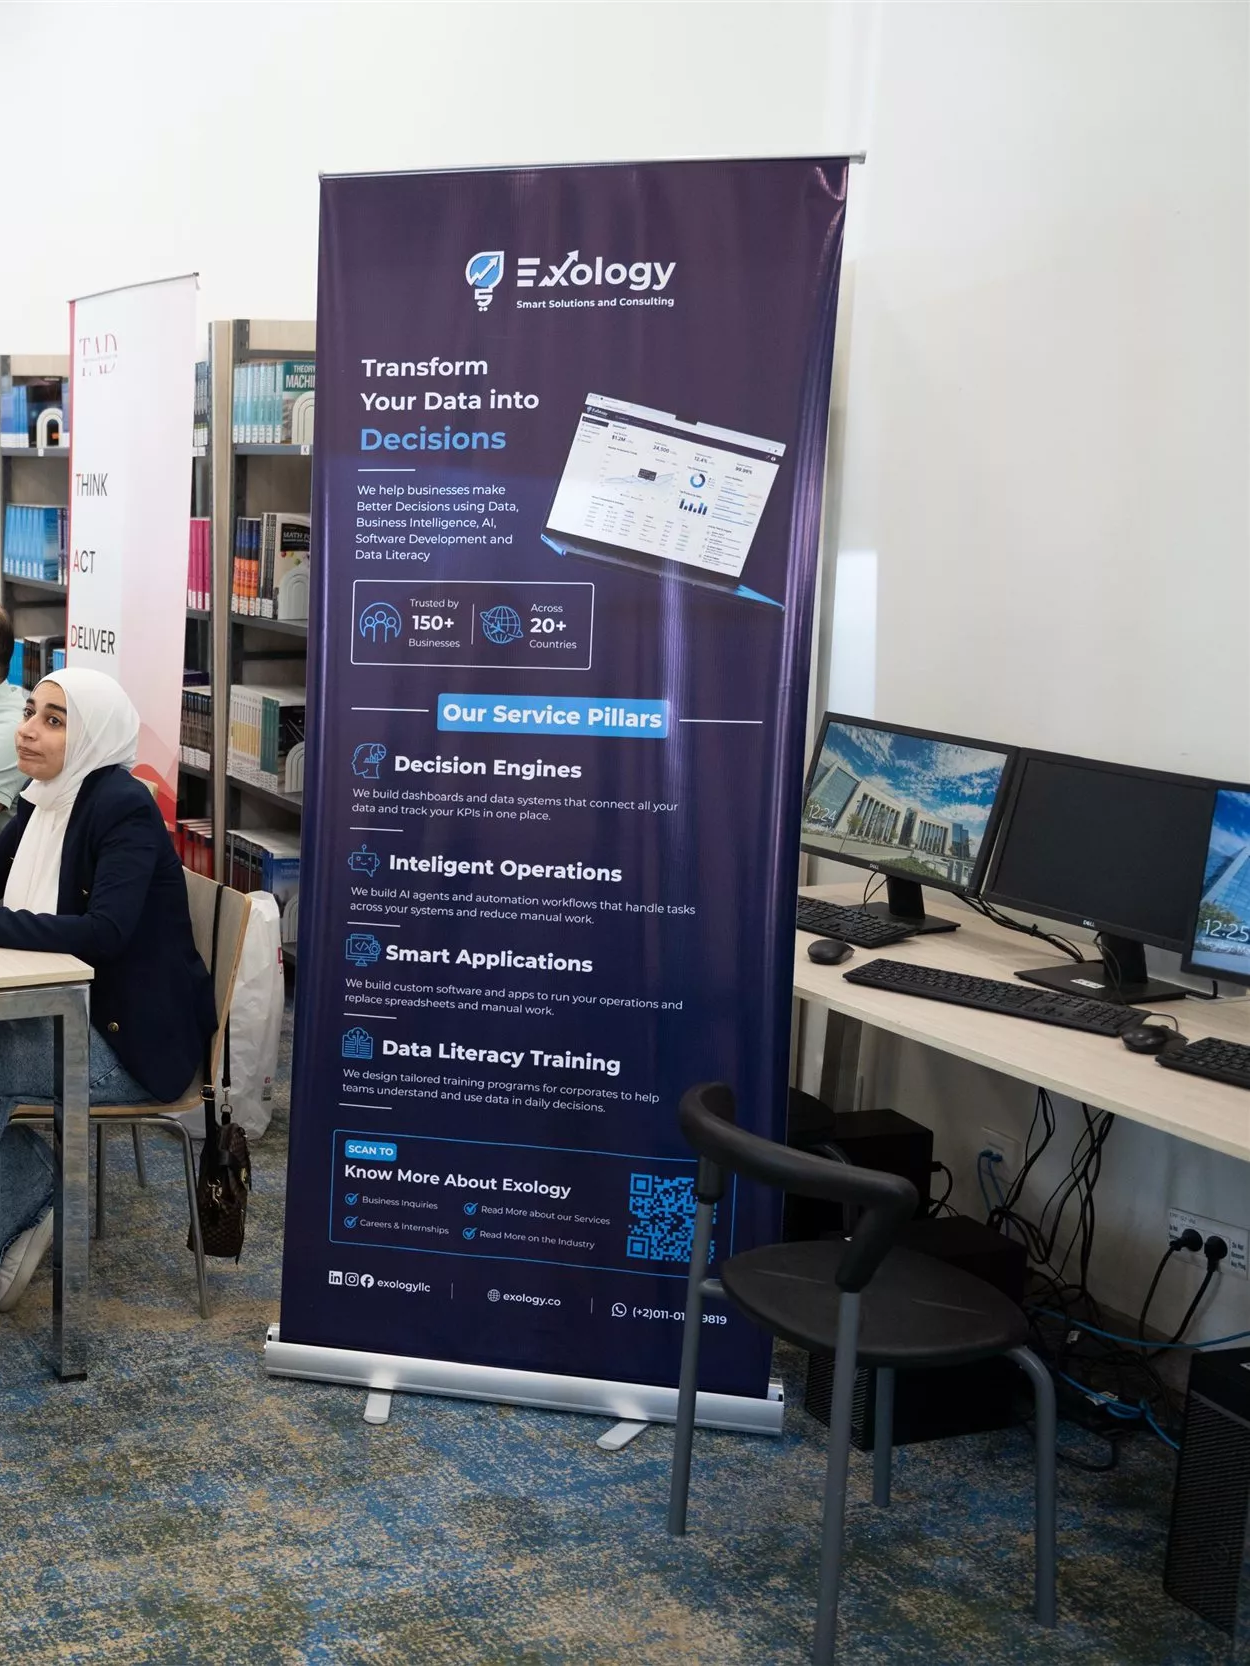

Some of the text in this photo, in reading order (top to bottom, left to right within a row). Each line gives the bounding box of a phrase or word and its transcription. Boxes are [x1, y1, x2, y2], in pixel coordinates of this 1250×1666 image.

[517, 250, 676, 291] Exology
[549, 299, 595, 308] Solutions
[598, 298, 616, 306] and
[619, 297, 674, 307] Consulting
[361, 357, 487, 377] Transform
[360, 389, 539, 410] Your Data into
[361, 425, 506, 450] Decisions
[76, 473, 108, 497] THINK
[357, 484, 505, 497] We help businesses make
[357, 501, 518, 513] Better Decisions using Data,
[357, 517, 496, 529] Business Intelligence, AI,
[356, 533, 512, 545] Software Development and
[73, 550, 96, 574] ACT
[356, 550, 430, 562] Data Literacy
[410, 599, 459, 609] Trusted by
[531, 604, 563, 612] Across
[412, 615, 454, 630] 150+
[530, 618, 566, 633] 20+
[70, 625, 115, 654] DELIVER
[409, 638, 460, 647] Businesses
[529, 639, 577, 649] Countries
[443, 704, 663, 728] Our Service Pillars
[395, 756, 582, 780] Decision Engines
[353, 788, 678, 813] We build dashboards and data systems that connect all your
[352, 803, 550, 821] data and track your KPIs in one place.
[808, 803, 837, 822] 12:24
[390, 855, 622, 882] Inteligent Operations
[351, 887, 695, 914] We build AI agents and automation workflows that handle tasks
[1083, 919, 1095, 927] DELL
[1204, 918, 1249, 942] 12:25
[386, 945, 592, 972] Smart Applications
[346, 978, 362, 988] We
[365, 979, 391, 990] build
[394, 984, 433, 992] custom
[436, 985, 482, 995] software
[485, 989, 505, 997] and
[508, 991, 534, 1000] apps
[537, 992, 548, 1000] to
[572, 995, 597, 1004] your
[599, 997, 659, 1008] operations
[661, 1001, 683, 1009] and
[383, 1040, 620, 1076] Data Literacy Training
[343, 1069, 659, 1104] We design tailored training programs for corporates to help
[343, 1084, 605, 1112] teams understand and use data in daily decisions.
[348, 1144, 394, 1156] SCAN TO
[345, 1165, 571, 1199] Know More About Exology
[362, 1196, 438, 1209] Business Inquiries
[481, 1206, 503, 1214] Read
[506, 1208, 527, 1216] More
[529, 1210, 555, 1219] about
[574, 1215, 610, 1225] Services
[360, 1219, 392, 1228] Careers
[402, 1223, 449, 1235] Internships
[480, 1230, 502, 1239] Read
[504, 1232, 526, 1240] More
[542, 1236, 556, 1244] the
[558, 1238, 595, 1250] Industry
[377, 1280, 430, 1292] exologyllc
[503, 1294, 561, 1306] exology.co
